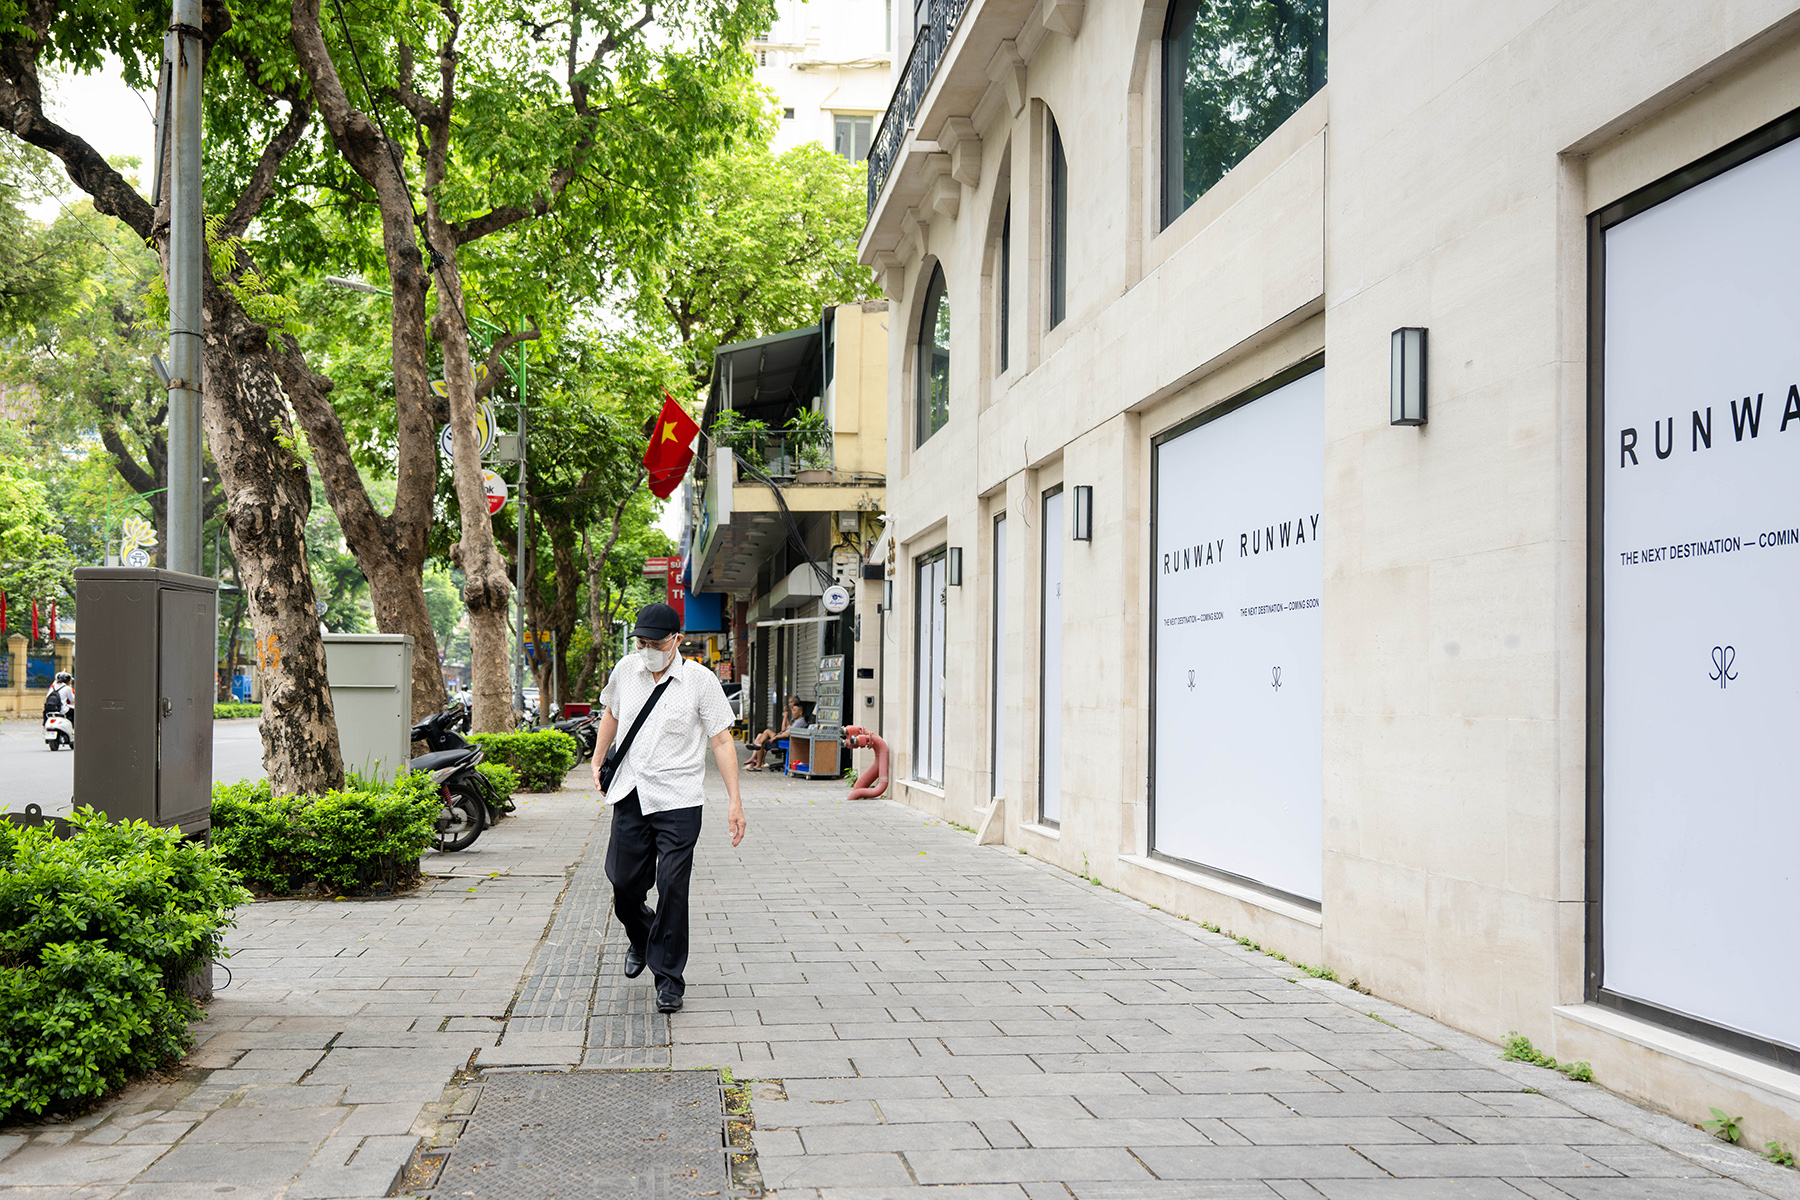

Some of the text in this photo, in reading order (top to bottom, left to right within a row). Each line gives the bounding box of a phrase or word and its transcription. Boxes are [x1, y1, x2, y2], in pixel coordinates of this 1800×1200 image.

[1240, 513, 1320, 558] RUNWAY
[1620, 551, 1639, 566] THE
[1641, 547, 1667, 563] NEXT
[1670, 536, 1741, 560] DESTINATION
[1758, 528, 1800, 548] COMIN
[1163, 539, 1224, 575] RUNWAY
[1248, 606, 1258, 616] NEXT
[1258, 603, 1283, 615] DESTINATION
[1288, 600, 1306, 610] COMING
[1306, 598, 1320, 608] SOON
